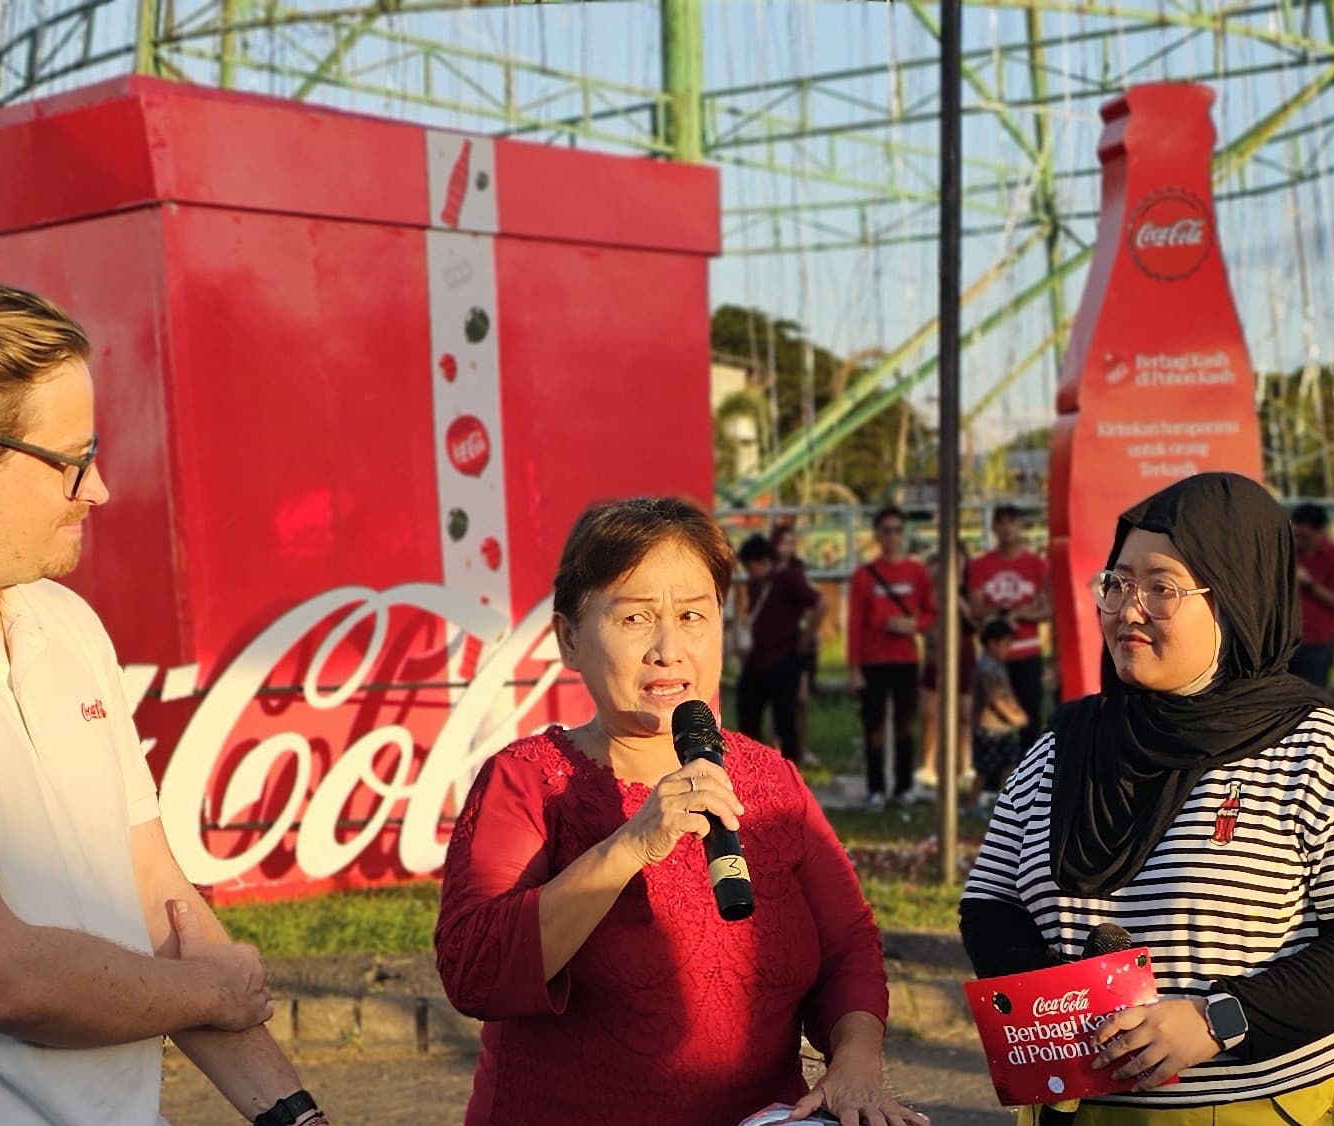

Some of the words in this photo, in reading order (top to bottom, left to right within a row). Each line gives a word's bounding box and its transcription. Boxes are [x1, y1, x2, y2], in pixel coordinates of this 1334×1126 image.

[1135, 219, 1203, 249] Coca-Cola
[1033, 988, 1090, 1018] Coca-Cola
[1003, 1018, 1078, 1044] Berbagi
[1007, 1049, 1026, 1066] di
[1027, 1039, 1090, 1064] Pohon
